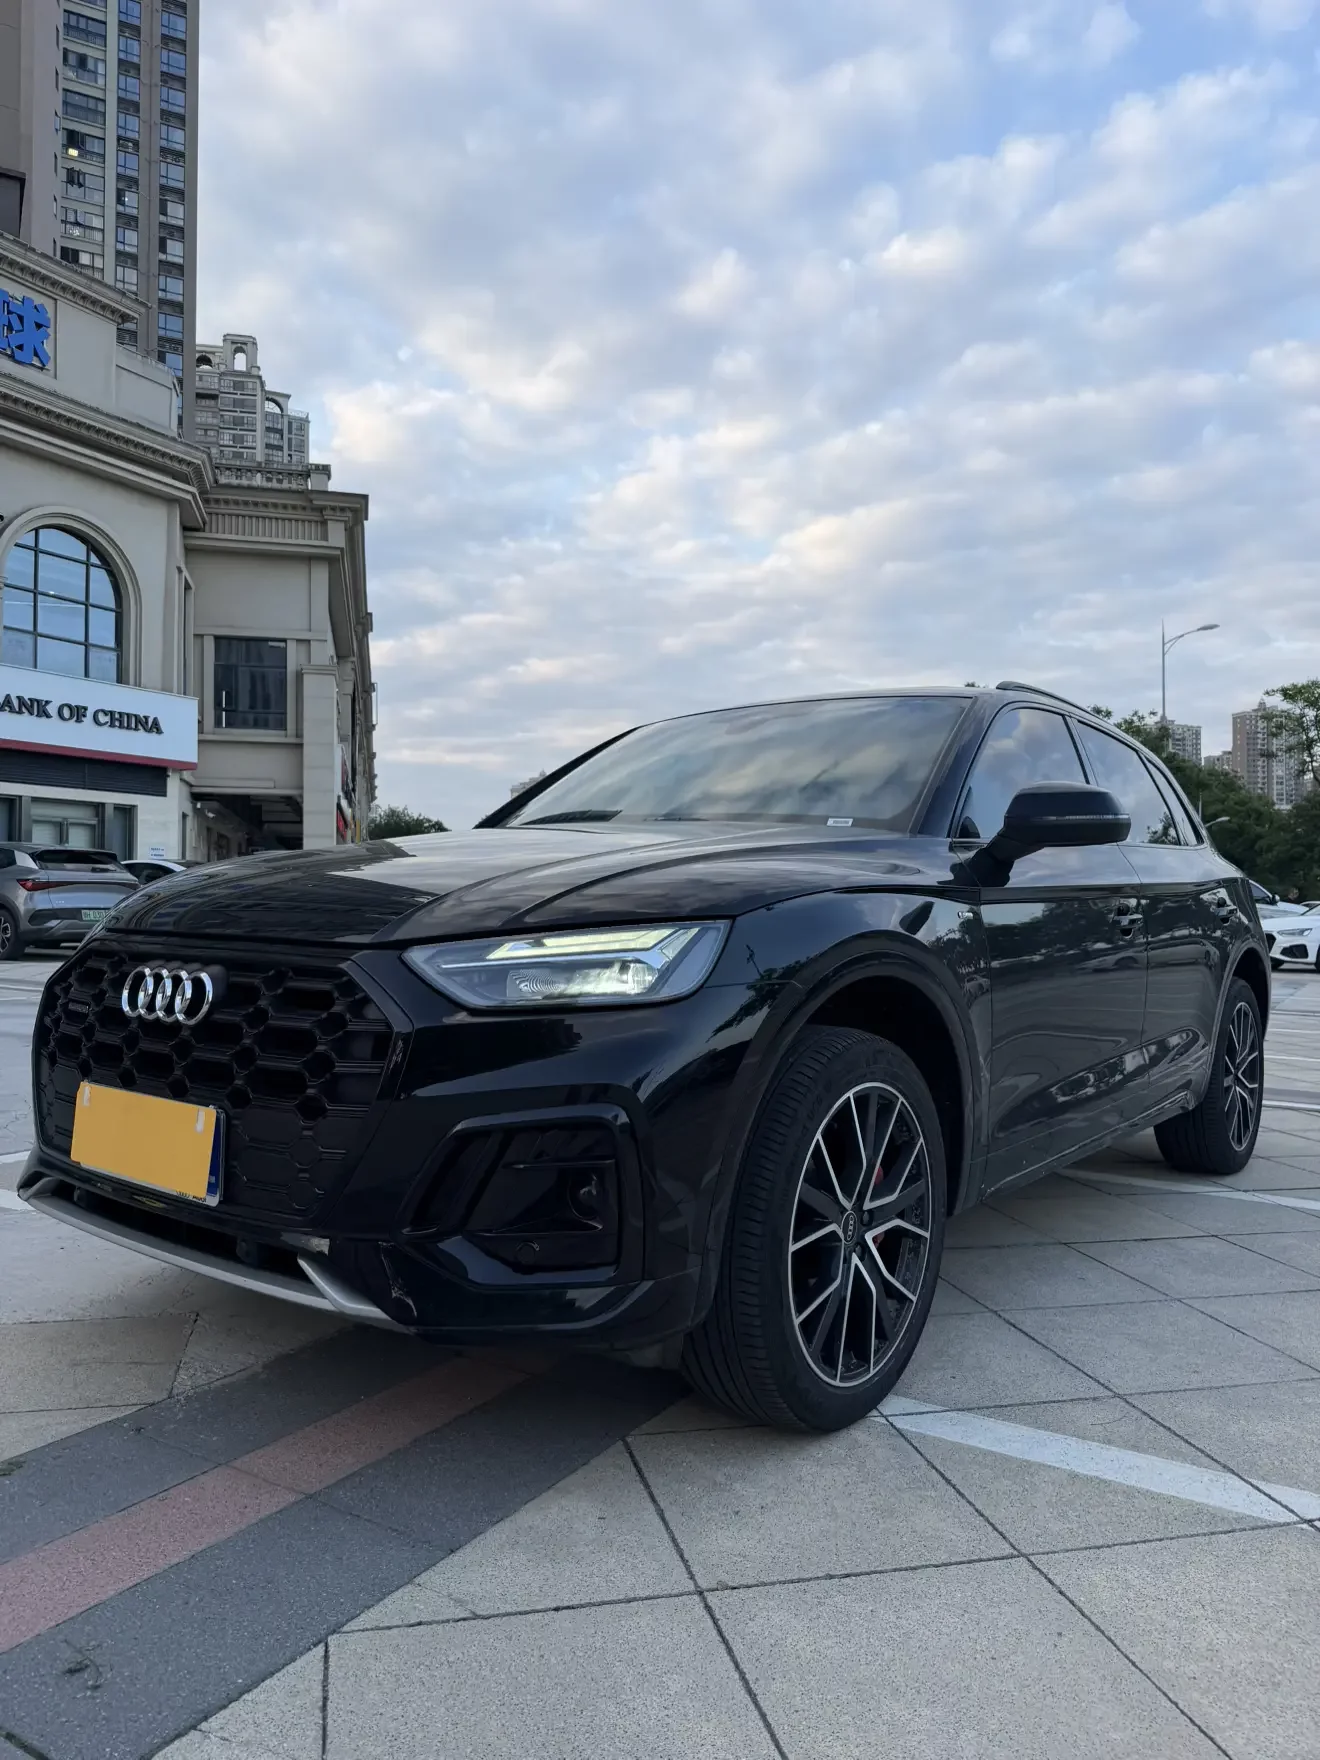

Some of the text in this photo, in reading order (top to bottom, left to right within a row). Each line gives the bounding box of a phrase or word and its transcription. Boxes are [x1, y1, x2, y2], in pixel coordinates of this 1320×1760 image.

[0, 693, 164, 735] ANK OF CHINA
